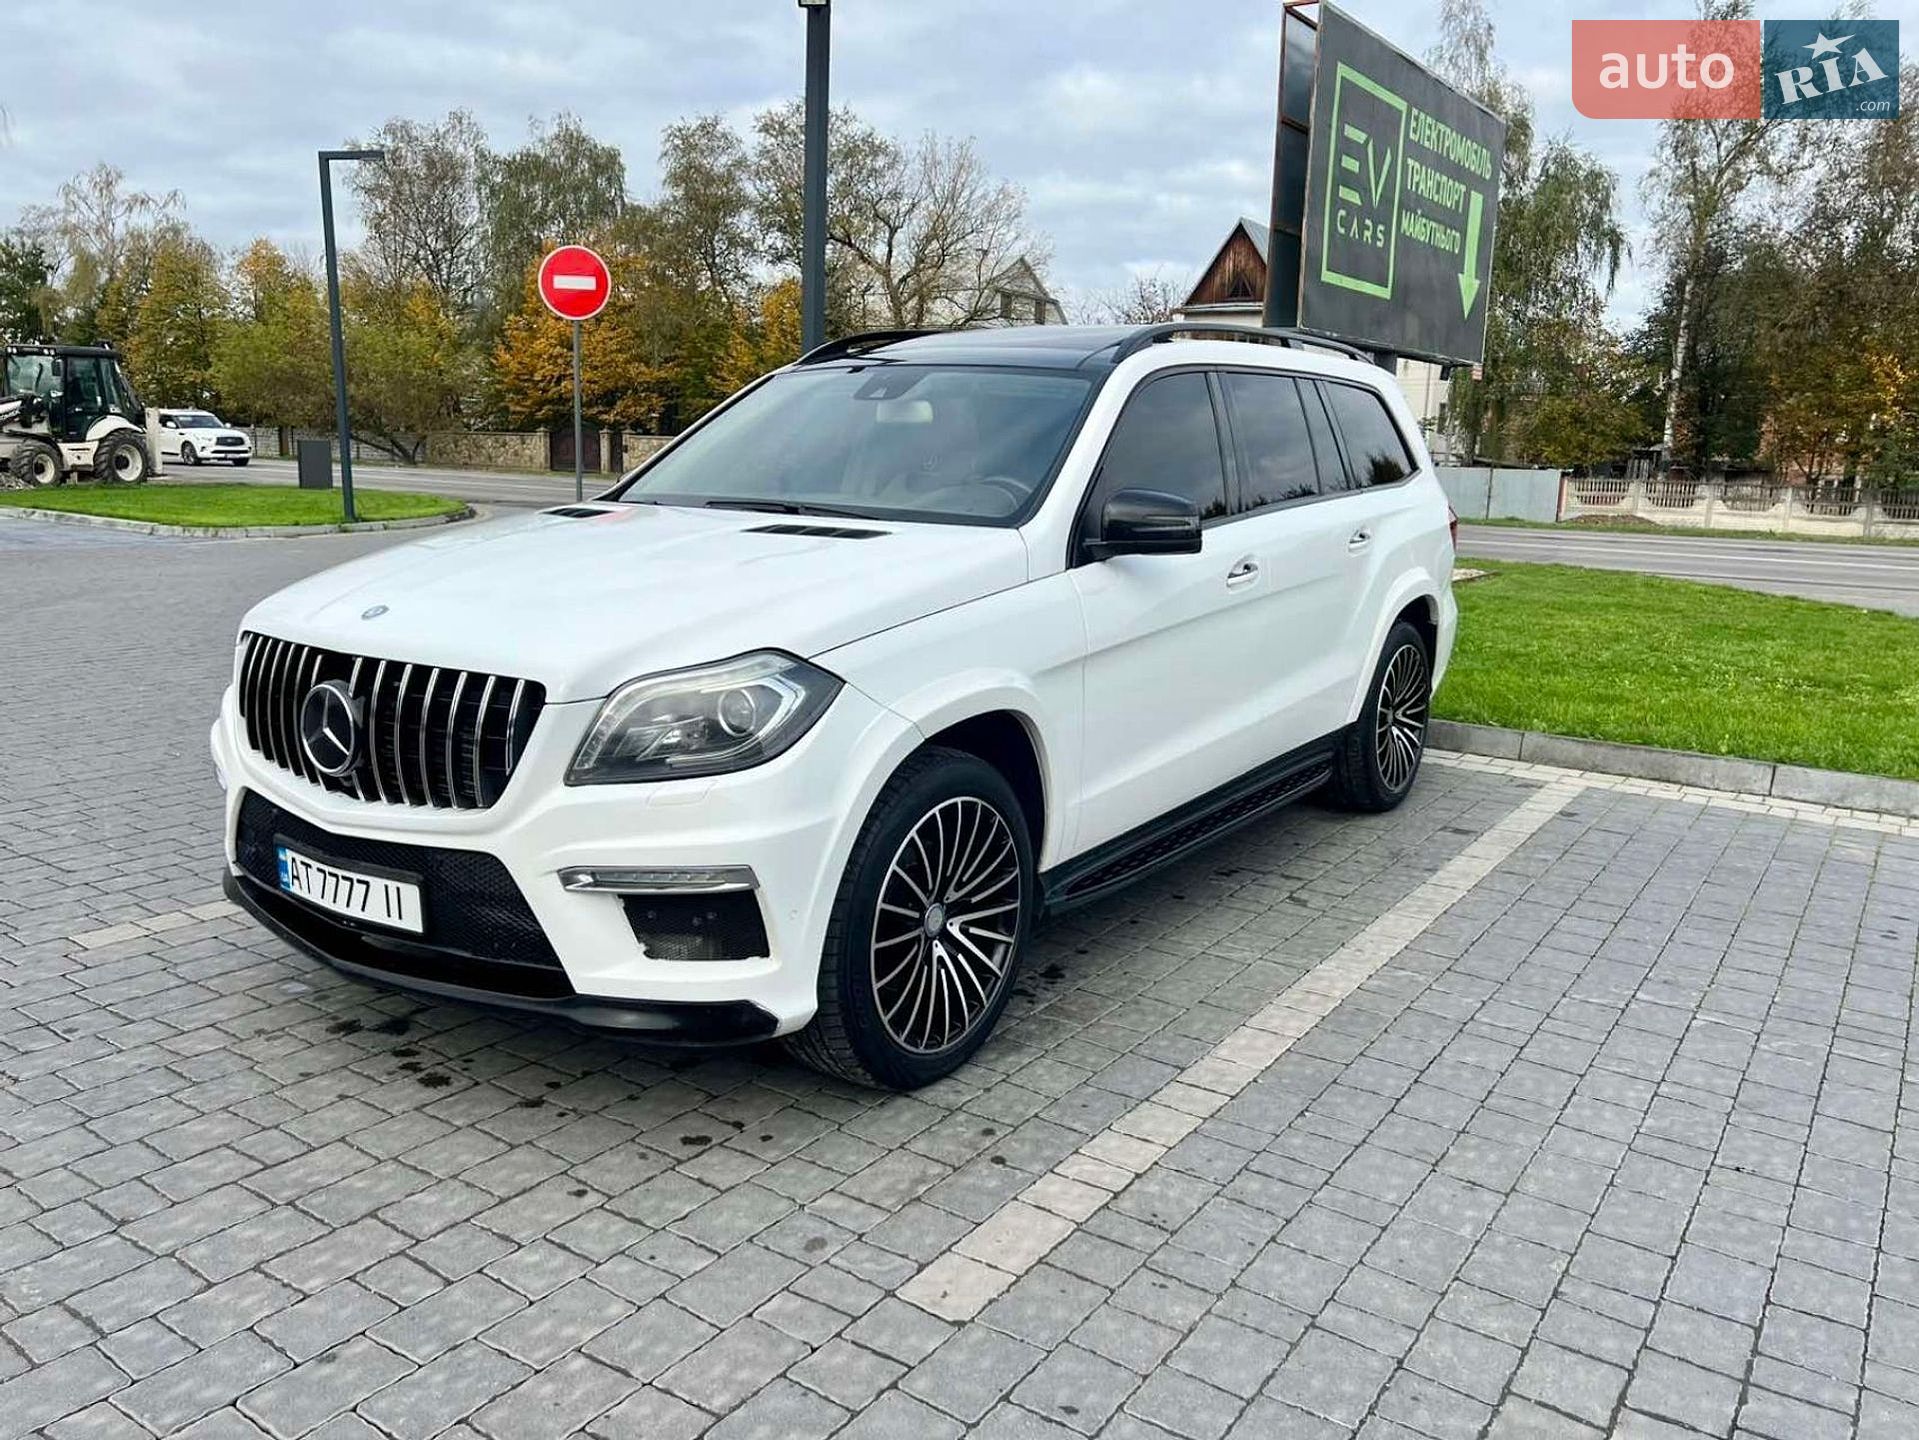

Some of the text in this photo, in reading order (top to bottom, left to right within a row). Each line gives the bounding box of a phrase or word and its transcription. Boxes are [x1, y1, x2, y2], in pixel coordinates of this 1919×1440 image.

[1339, 123, 1392, 208] EV
[1409, 106, 1492, 180] ЕЛЕКТРОМОБІЛЬ
[1407, 157, 1467, 214] ТРАНСПОРТ
[1337, 209, 1385, 248] CARS
[1401, 209, 1461, 255] МАЙБУТНЬОГО
